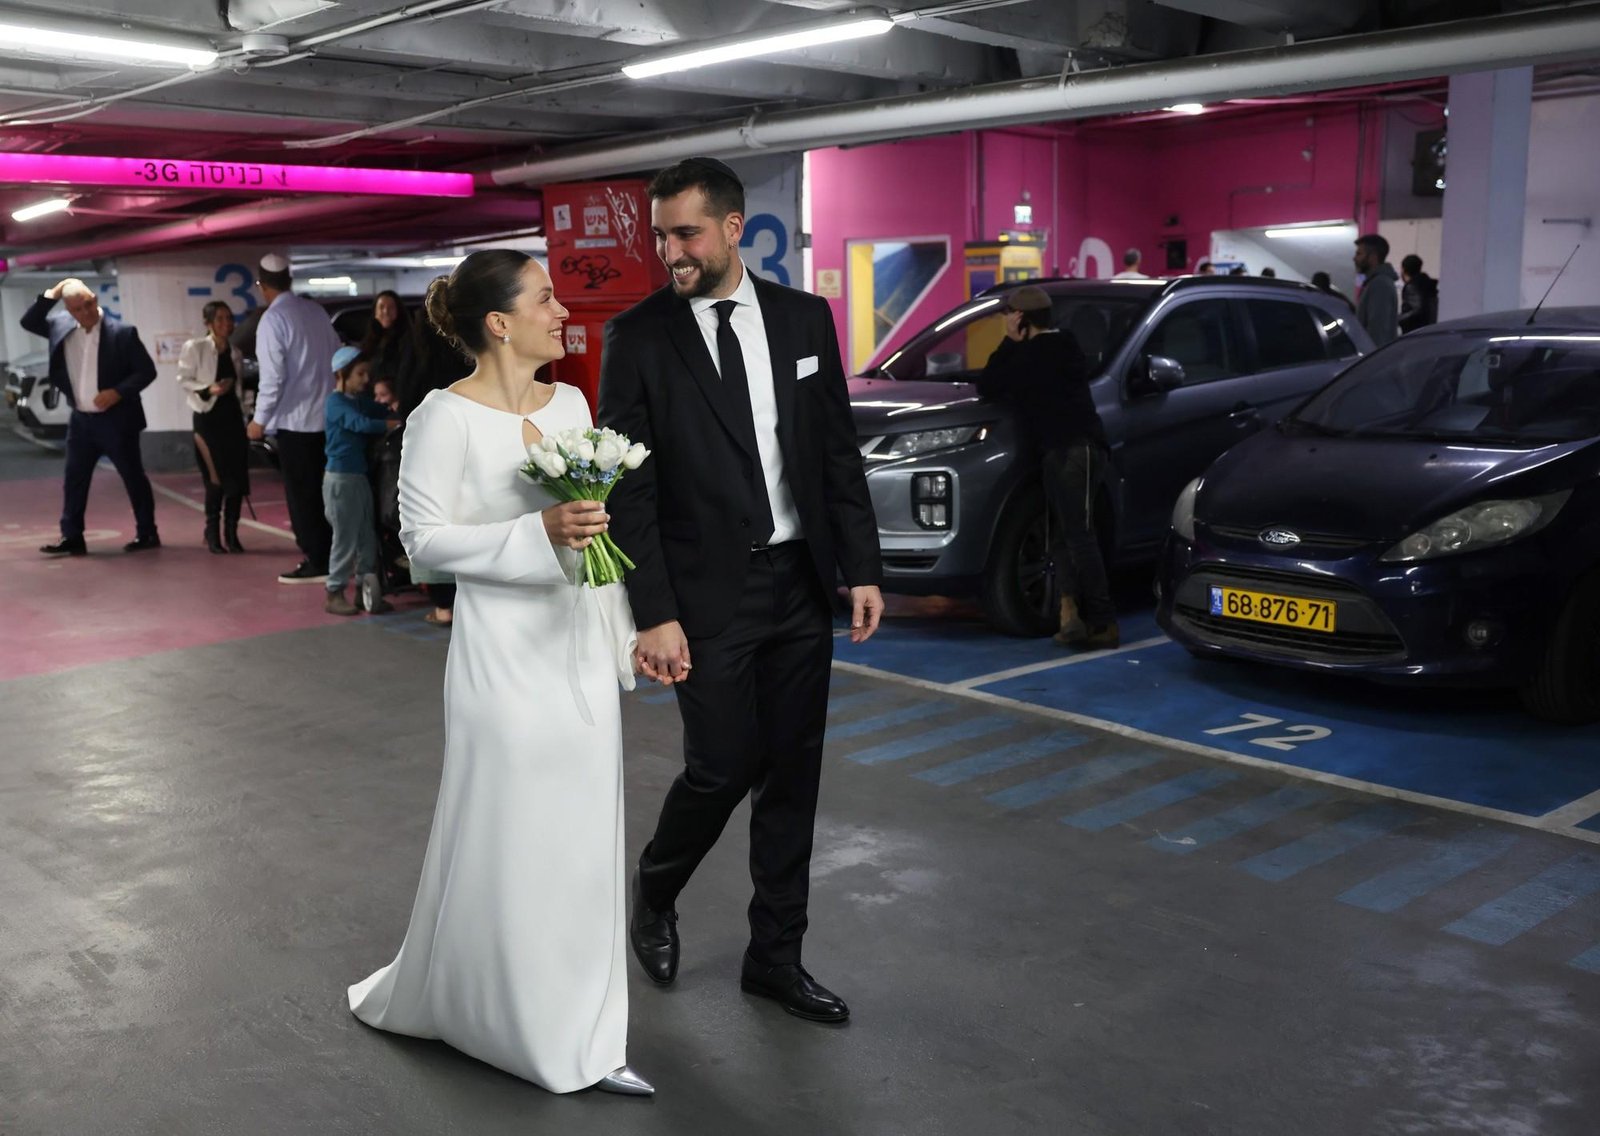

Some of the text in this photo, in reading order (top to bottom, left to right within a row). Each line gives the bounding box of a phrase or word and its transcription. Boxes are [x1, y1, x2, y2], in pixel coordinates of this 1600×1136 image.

[134, 162, 262, 185] כניסה -3G
[585, 214, 607, 226] אש
[187, 263, 258, 323] -3
[568, 334, 585, 345] אש
[1263, 529, 1299, 544] Ford
[1202, 712, 1332, 751] 72
